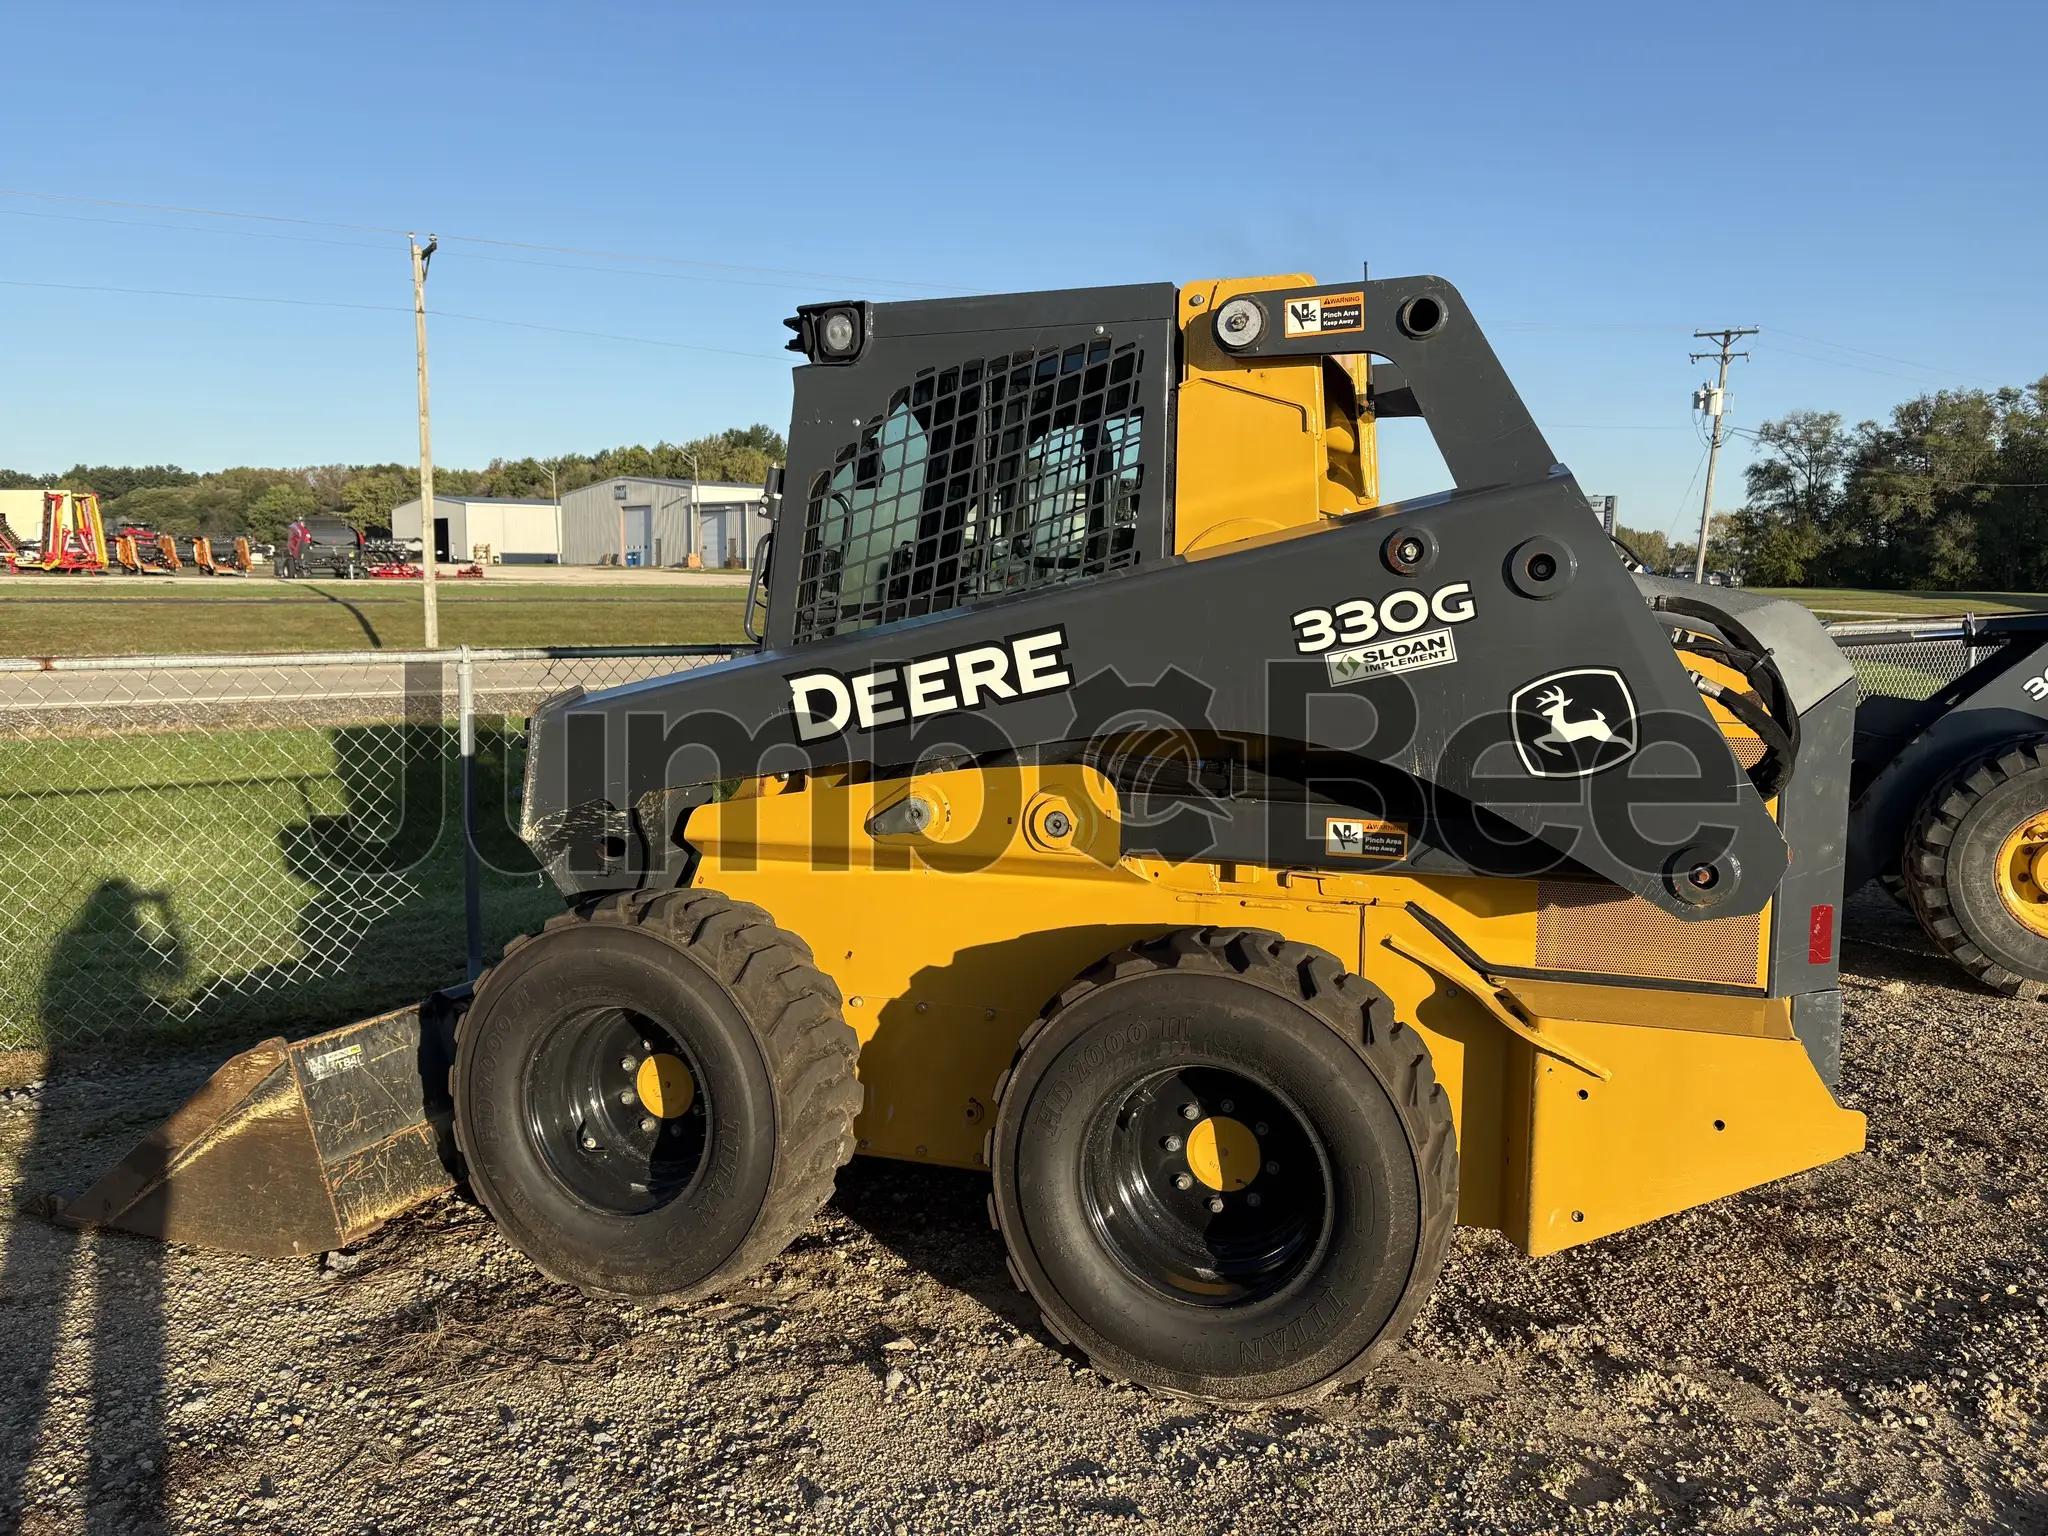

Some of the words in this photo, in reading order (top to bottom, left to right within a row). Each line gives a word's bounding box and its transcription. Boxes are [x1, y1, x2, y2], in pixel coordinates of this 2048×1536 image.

[1323, 311, 1342, 319] Pinch
[1330, 295, 1360, 304] WARNING
[1293, 583, 1476, 652] 330G
[1362, 636, 1446, 664] SLOAN
[1364, 649, 1448, 673] IMPLEMENT
[789, 631, 1071, 741] DEERE
[2022, 666, 2048, 701] 3
[1365, 836, 1385, 844] Pinch
[1385, 837, 1402, 845] Area
[1033, 1079, 1074, 1137] HD
[1067, 1020, 1149, 1085] 2000
[695, 1117, 742, 1228] TITAN
[1239, 1285, 1352, 1366] TITAN
